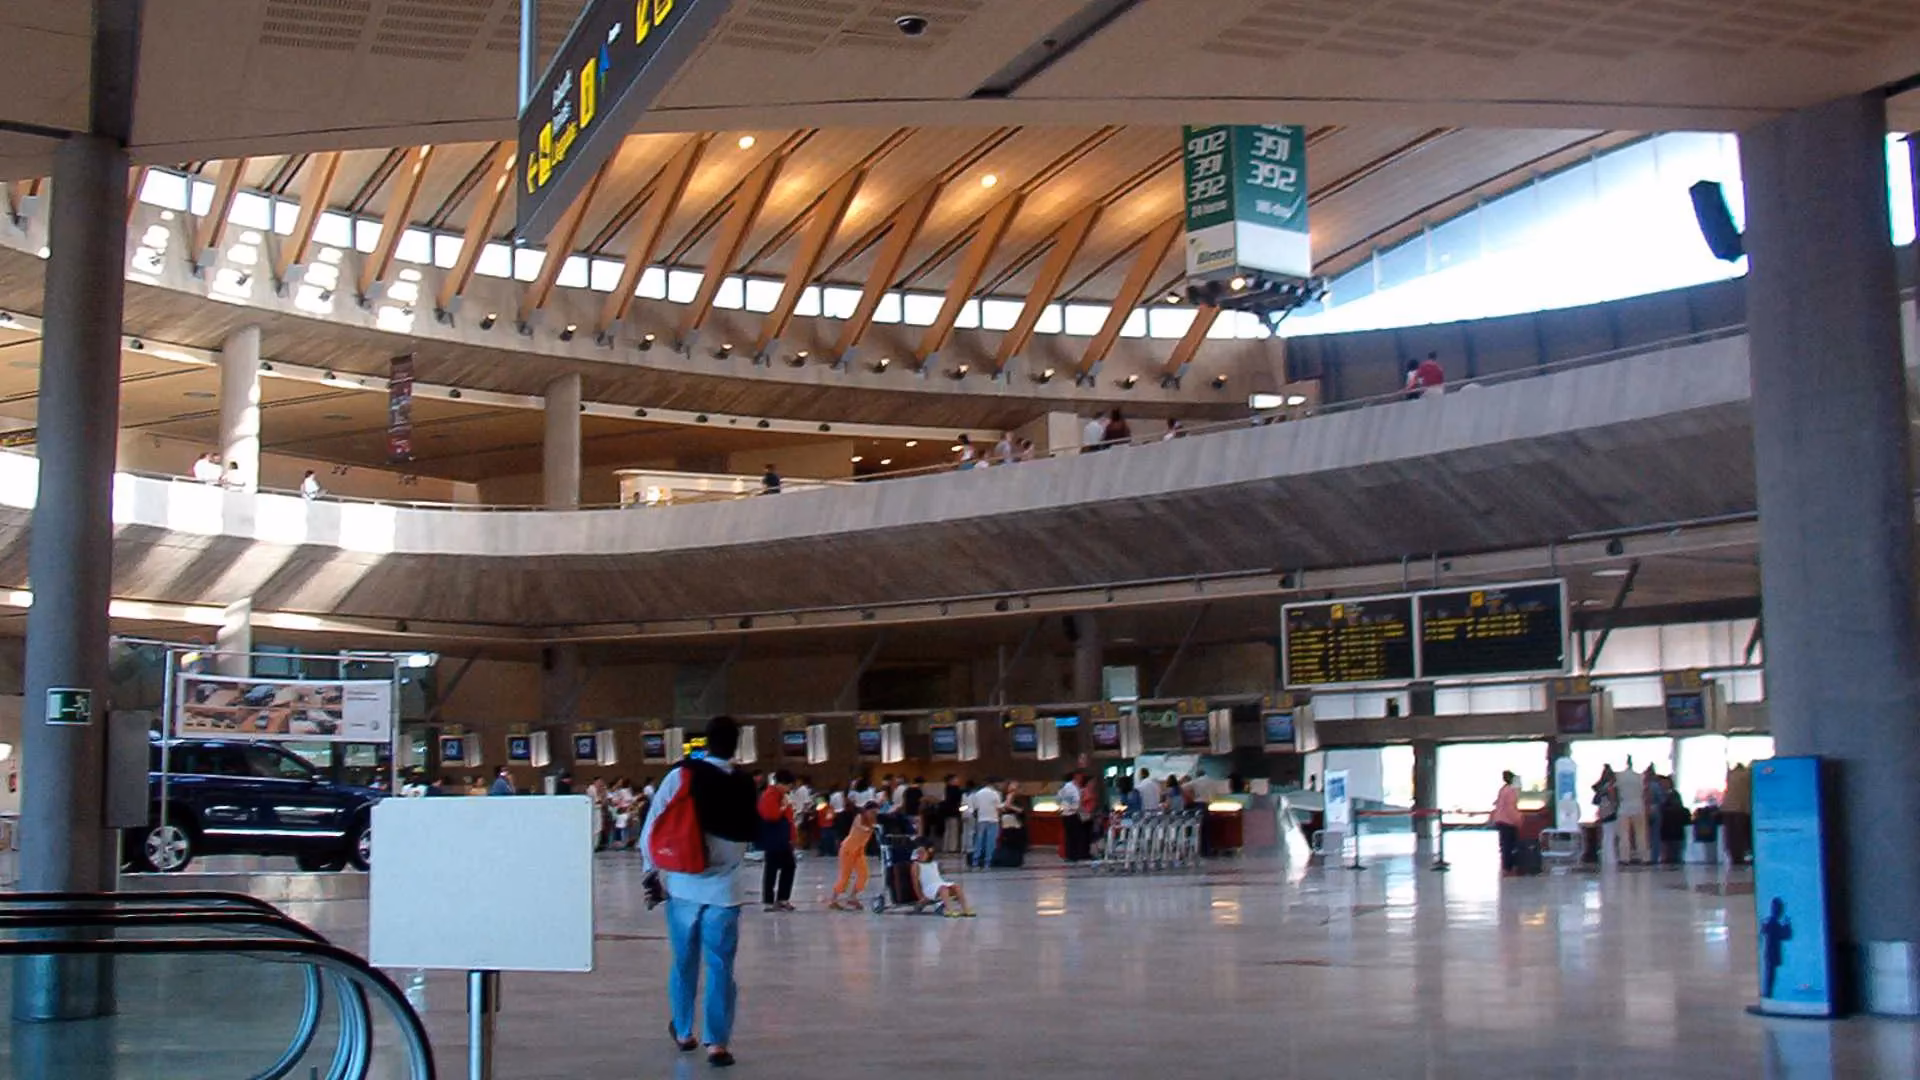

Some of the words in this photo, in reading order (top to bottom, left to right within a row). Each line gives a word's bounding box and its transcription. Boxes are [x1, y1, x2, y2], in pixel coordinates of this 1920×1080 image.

[1188, 130, 1227, 159] 902
[1249, 131, 1291, 162] 391
[1192, 153, 1224, 180] 391
[1246, 160, 1297, 192] 392
[1188, 174, 1226, 202] 392
